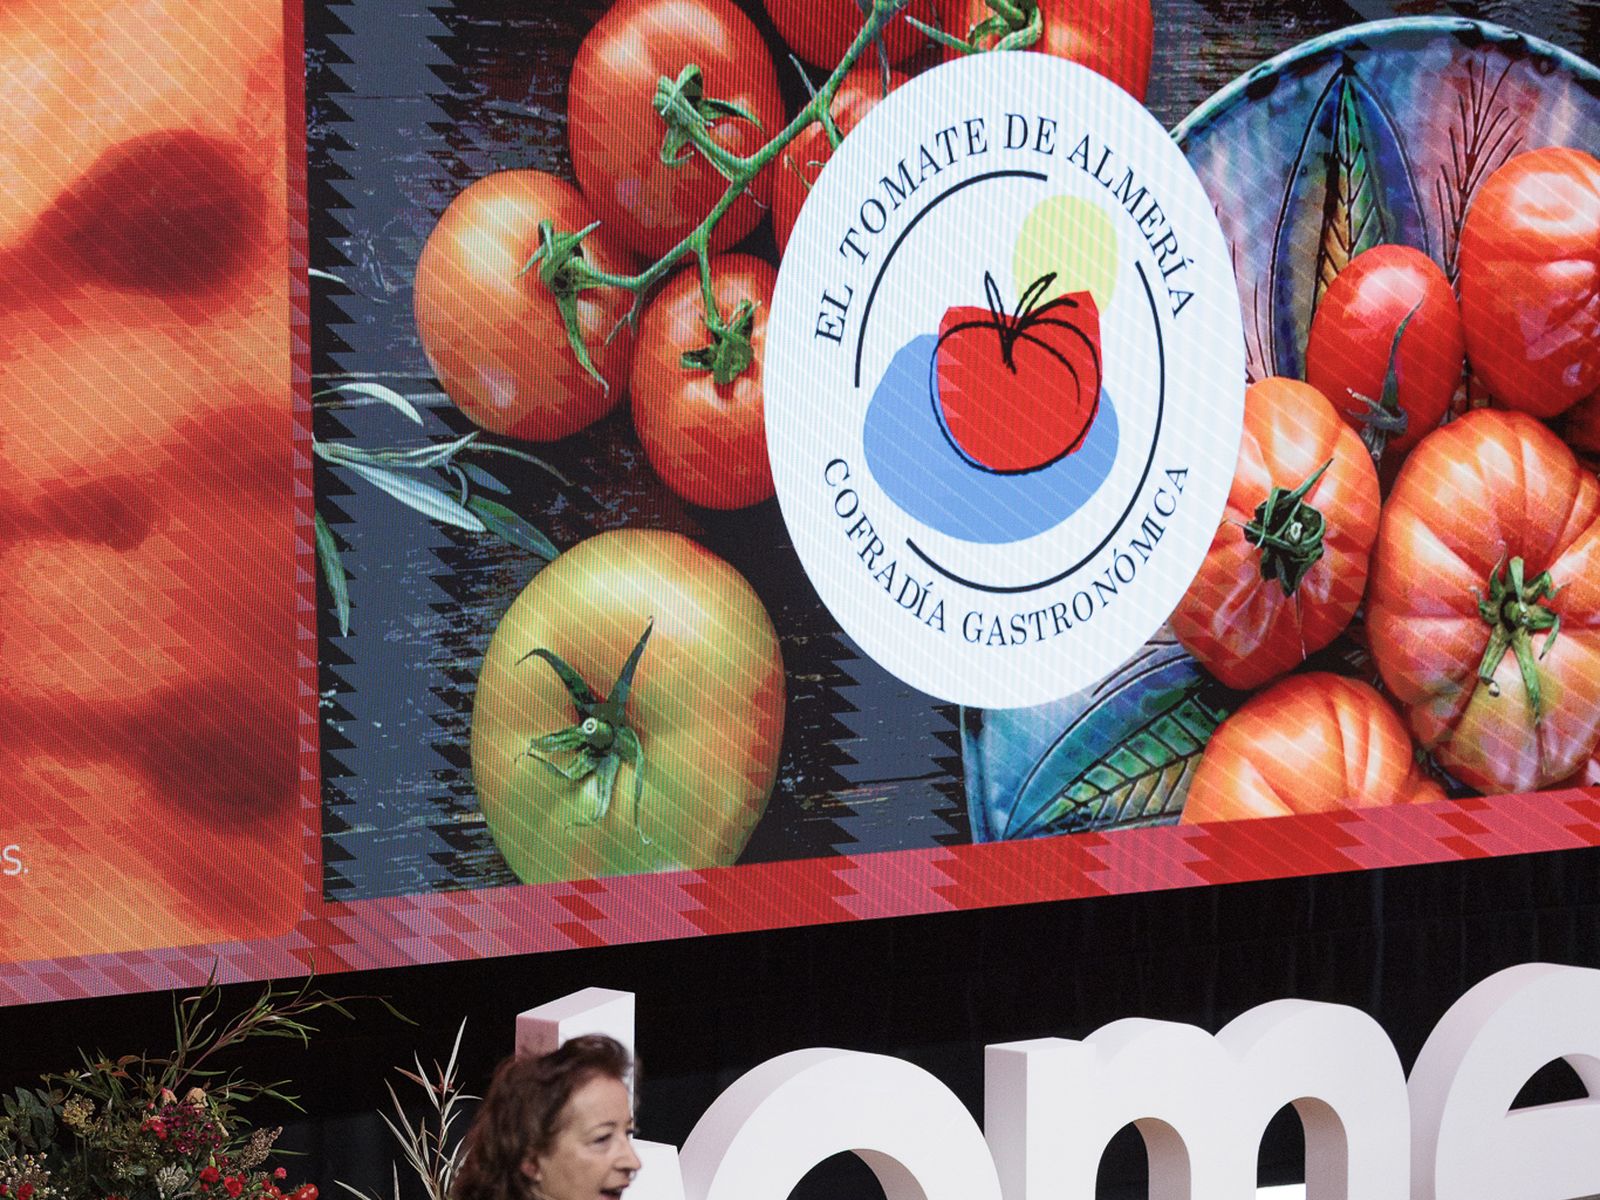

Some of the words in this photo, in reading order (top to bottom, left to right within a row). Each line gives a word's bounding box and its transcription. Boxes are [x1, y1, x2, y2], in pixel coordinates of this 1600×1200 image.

[814, 285, 854, 346] EL
[839, 117, 988, 265] TOMATE
[1003, 113, 1057, 155] DE
[1066, 134, 1195, 319] ALMERÍA
[824, 458, 946, 633] COFRADÍA
[962, 467, 1189, 646] GASTRONÓMICA
